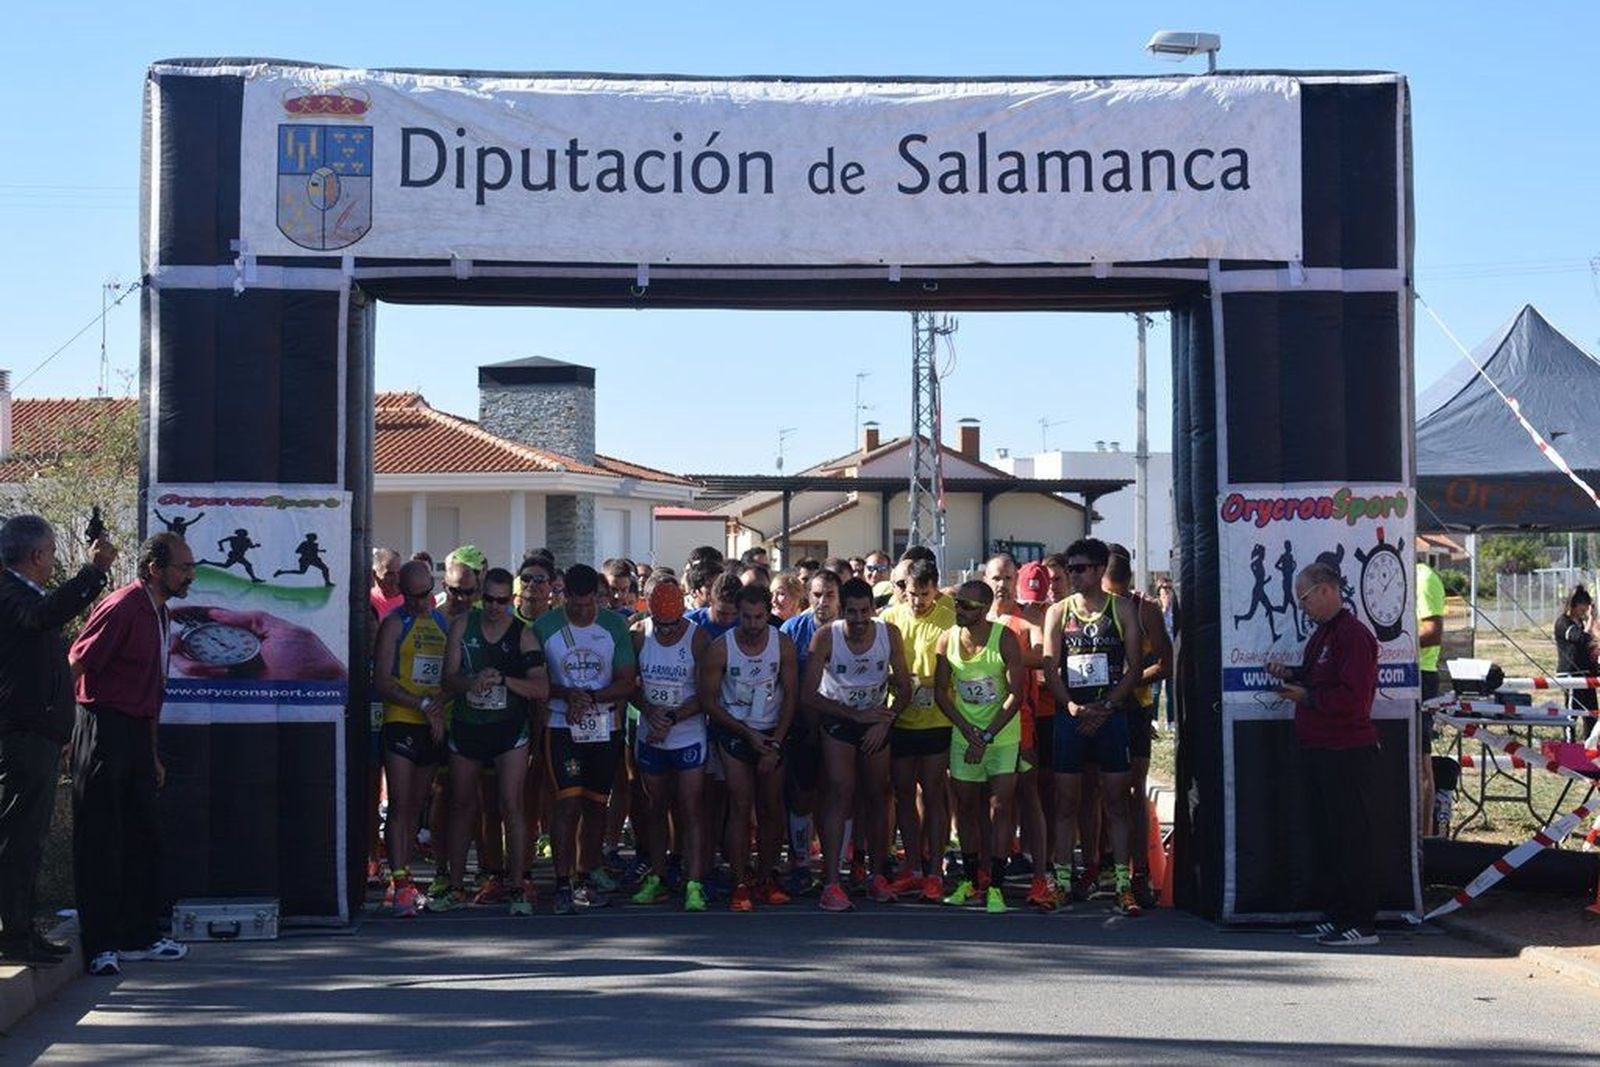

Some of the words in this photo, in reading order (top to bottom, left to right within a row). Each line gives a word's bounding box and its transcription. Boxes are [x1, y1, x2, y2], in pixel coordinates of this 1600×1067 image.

[400, 127, 774, 205] Diputación
[807, 146, 866, 195] de
[897, 131, 1251, 195] Salamanca
[1221, 487, 1409, 529] OrycronSport
[422, 662, 439, 676] 28
[651, 688, 669, 702] 28
[967, 685, 984, 698] 12
